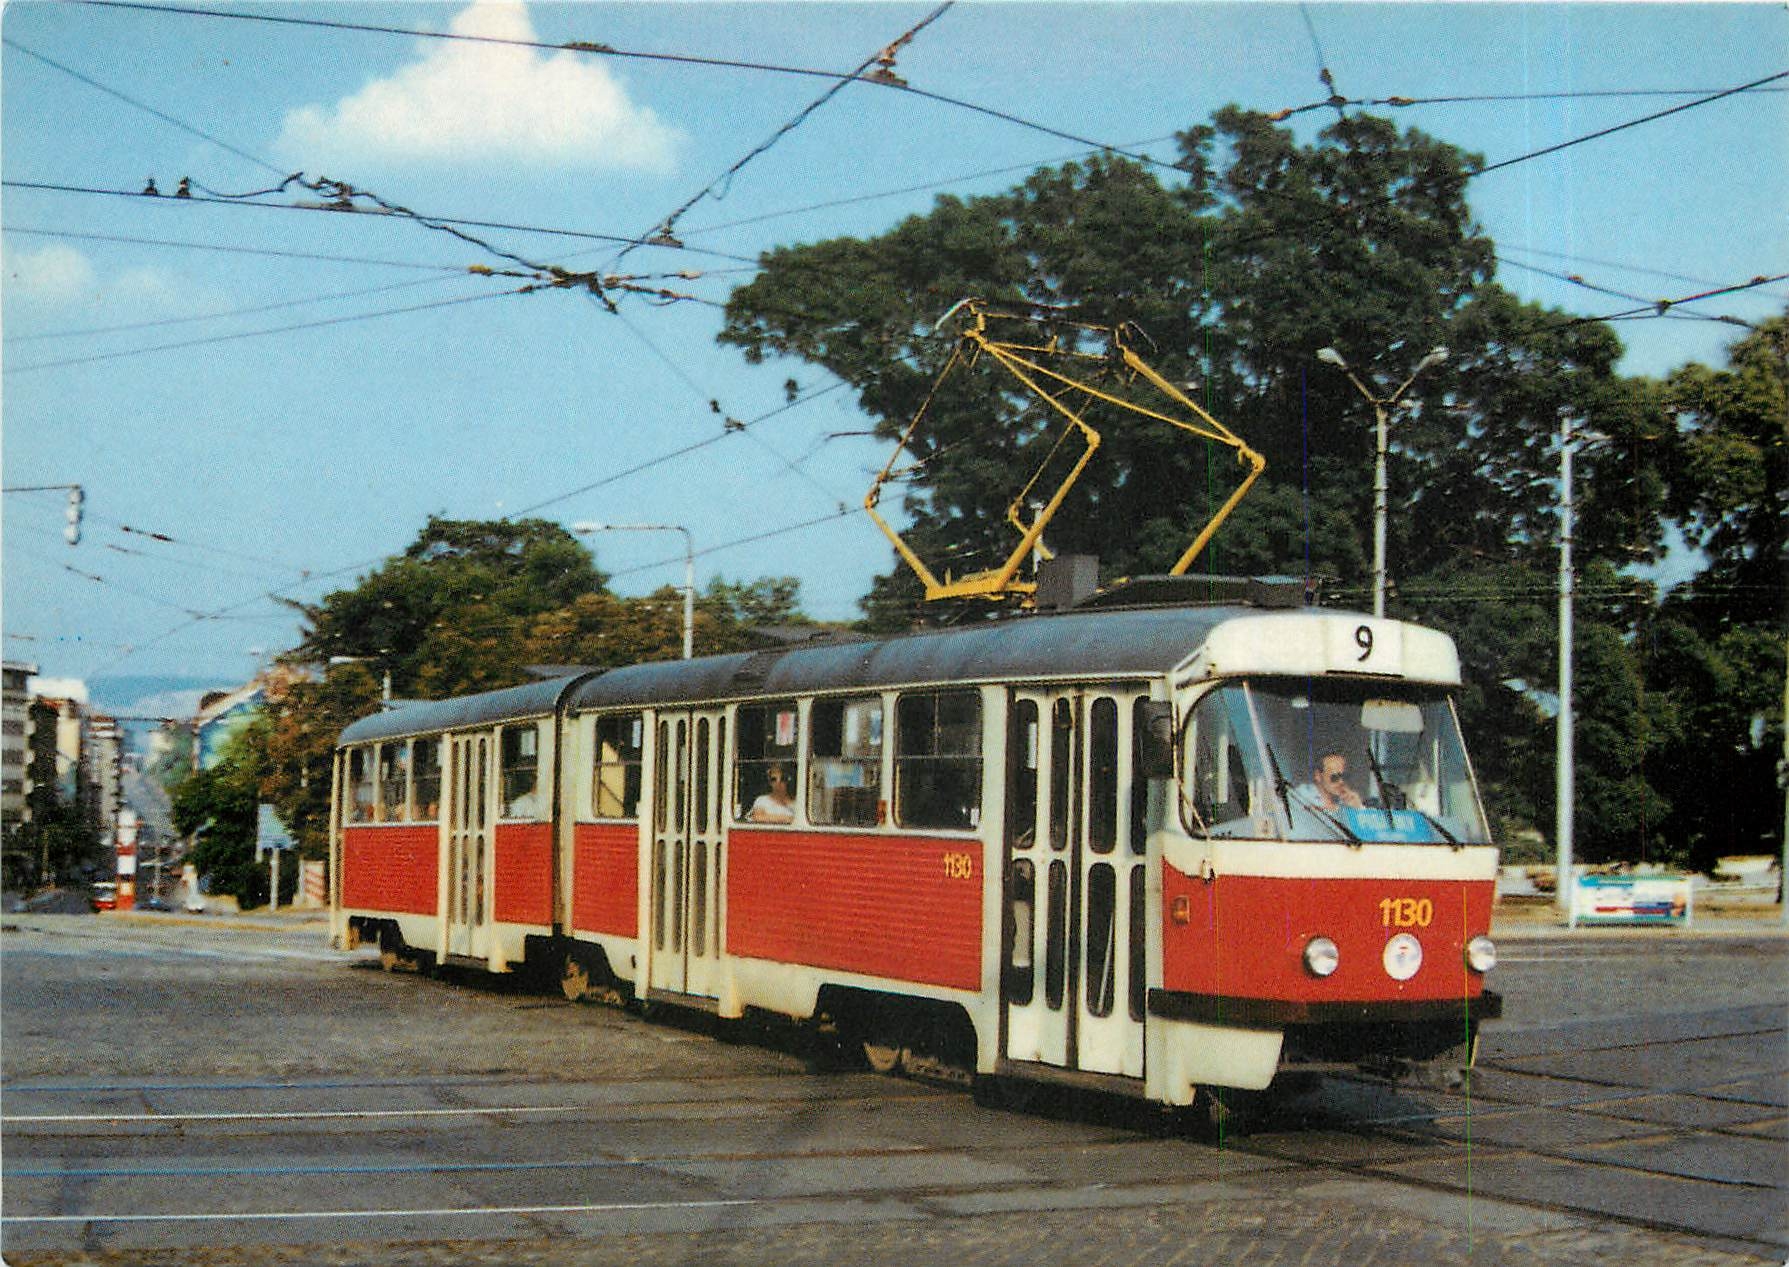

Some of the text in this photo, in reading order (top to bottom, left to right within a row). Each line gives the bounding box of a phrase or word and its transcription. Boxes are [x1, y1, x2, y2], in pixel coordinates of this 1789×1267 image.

[1356, 625, 1373, 661] 9
[943, 852, 972, 879] 1130
[1379, 897, 1433, 927] 1130
